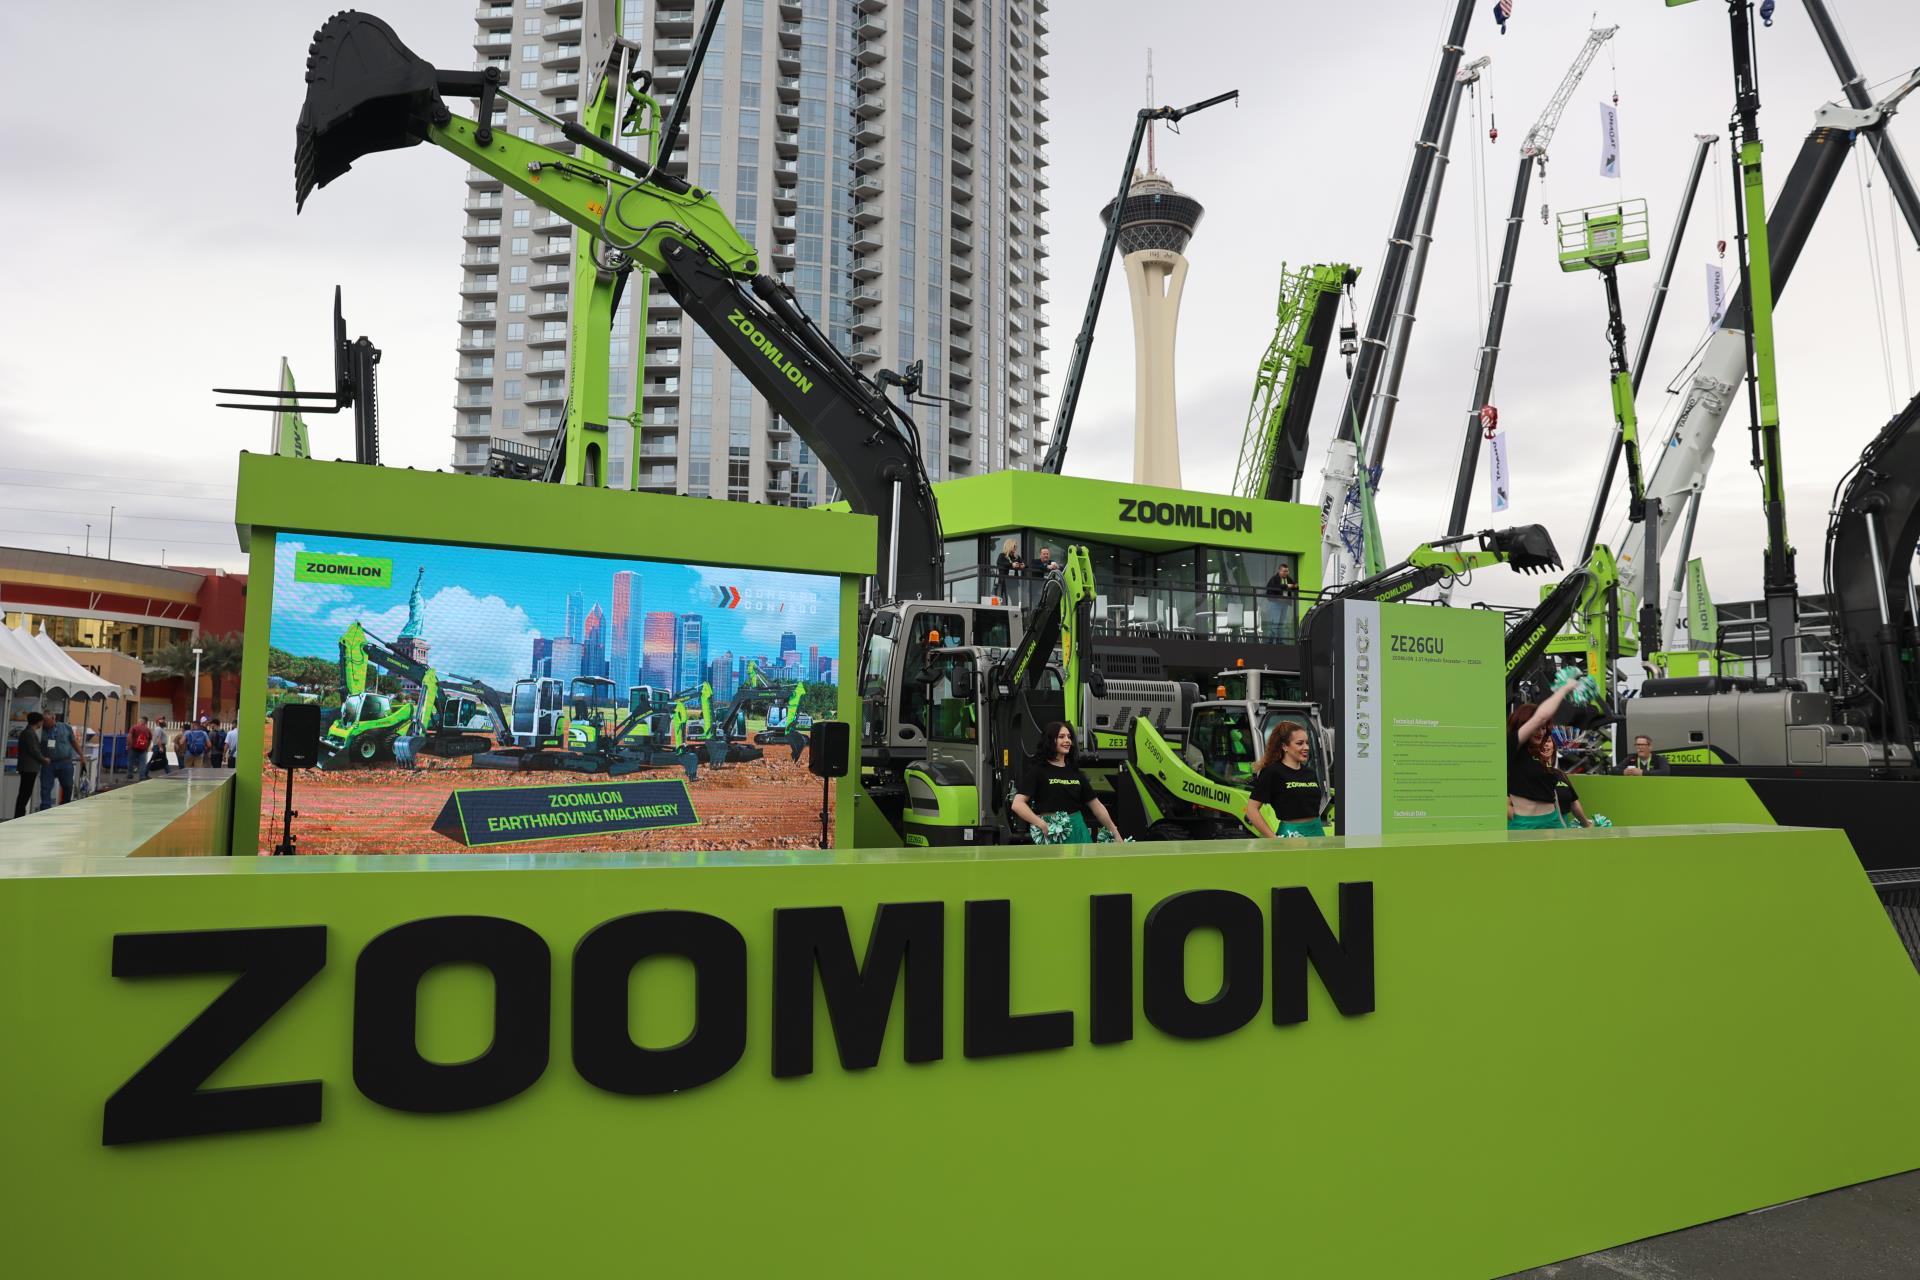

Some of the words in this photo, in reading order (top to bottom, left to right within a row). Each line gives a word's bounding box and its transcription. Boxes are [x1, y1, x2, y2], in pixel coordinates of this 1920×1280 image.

[727, 309, 813, 394] ZOOMLION
[1679, 398, 1696, 427] TADANO
[1118, 498, 1253, 533] ZOOMLION
[306, 562, 381, 577] ZOOMLION
[1390, 635, 1444, 655] ZE26GU
[1504, 624, 1547, 677] OOMLION
[1012, 639, 1037, 685] ZOOMLION
[1355, 616, 1370, 759] ZOOMLION
[1662, 754, 1702, 762] E210GLC
[548, 791, 622, 808] ZOOMLION
[1182, 780, 1231, 804] ZOOMLION
[487, 807, 602, 832] EARTHMOVING
[604, 801, 679, 822] MACHINERY
[102, 882, 1376, 1149] ZOOMLION
